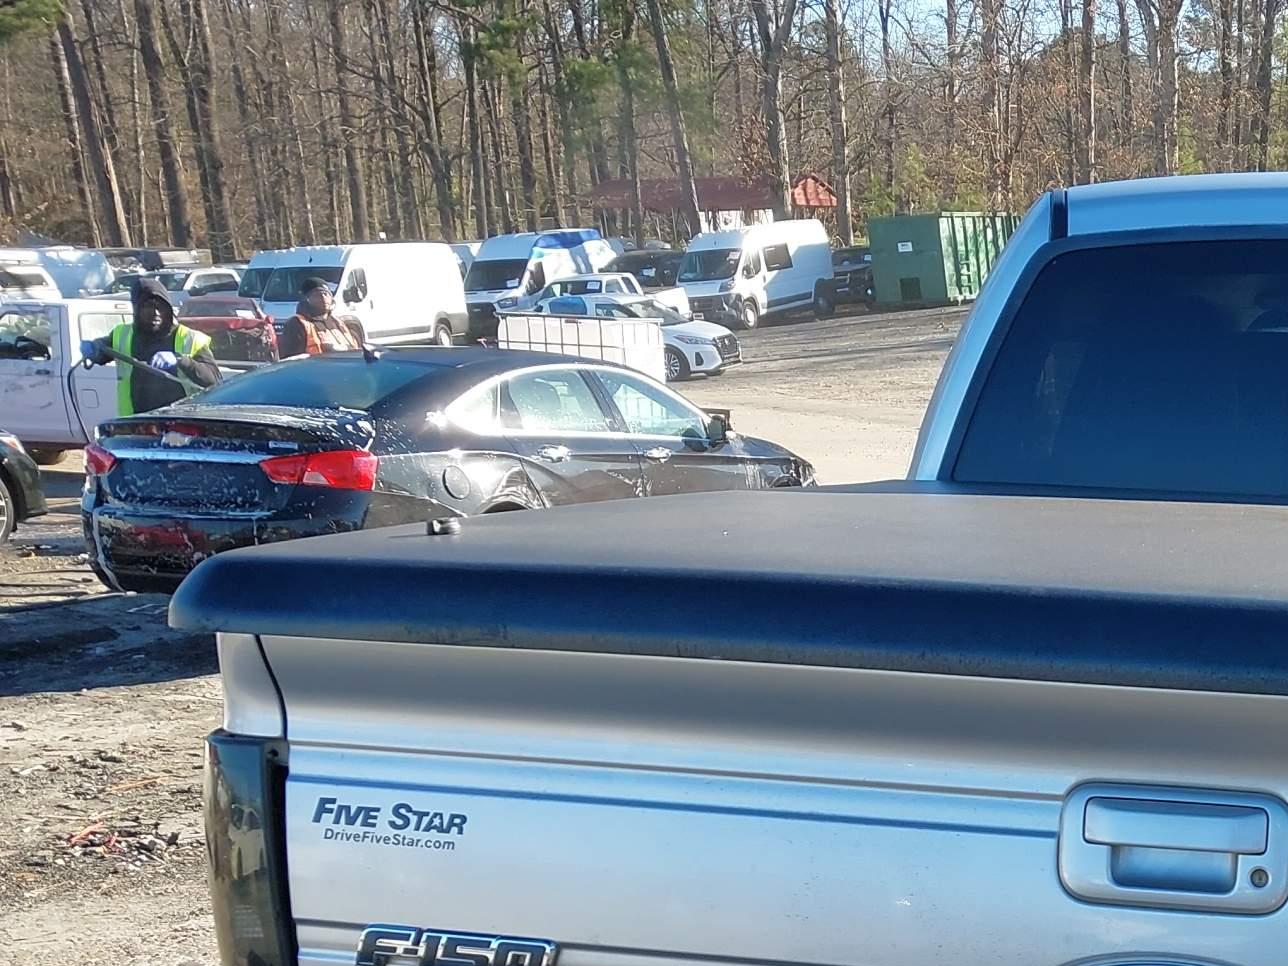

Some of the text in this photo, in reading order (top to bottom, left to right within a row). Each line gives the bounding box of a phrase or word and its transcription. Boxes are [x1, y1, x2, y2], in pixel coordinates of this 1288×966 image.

[312, 797, 468, 835] FIVE STAR
[323, 828, 456, 850] DriveFiveStar.com
